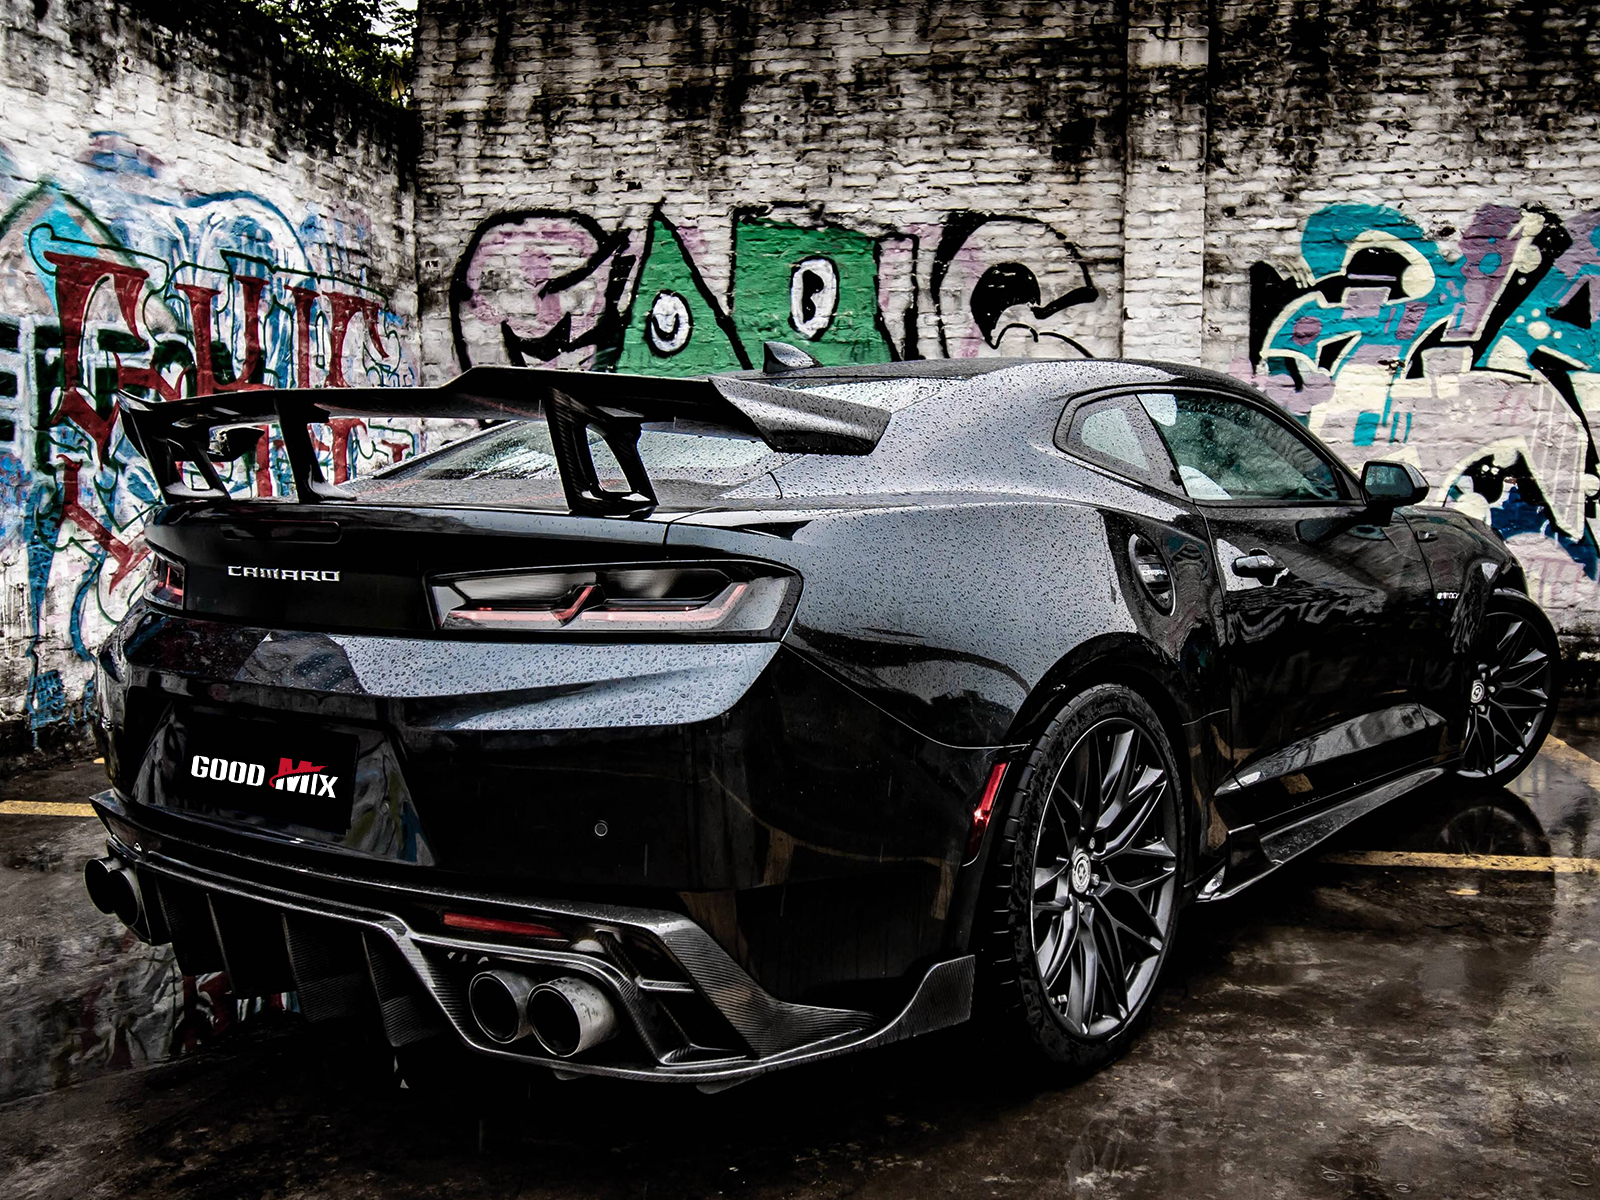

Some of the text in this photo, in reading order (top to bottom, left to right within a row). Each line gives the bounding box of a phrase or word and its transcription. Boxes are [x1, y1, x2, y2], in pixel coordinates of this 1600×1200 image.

[227, 565, 341, 582] CAMARO
[190, 754, 339, 799] GOOD MIX
